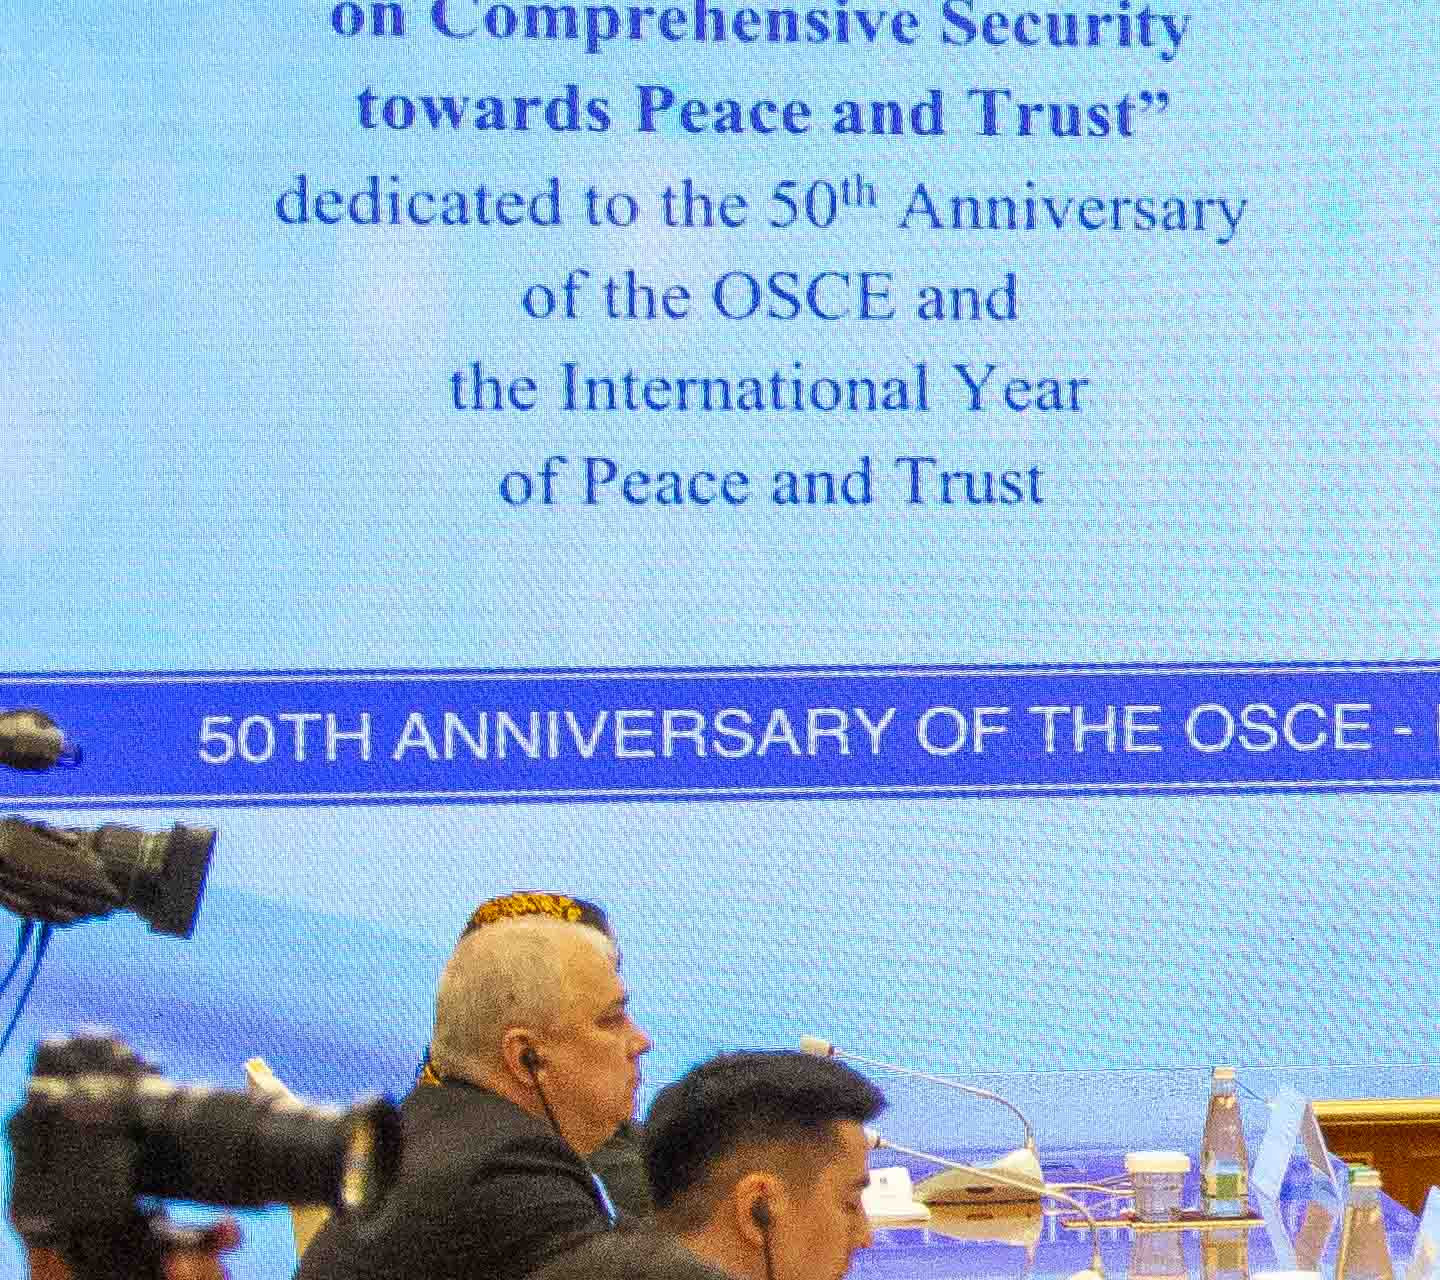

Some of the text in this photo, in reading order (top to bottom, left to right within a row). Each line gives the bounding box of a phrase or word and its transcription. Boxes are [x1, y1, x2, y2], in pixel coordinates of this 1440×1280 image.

[331, 1, 404, 36] on
[941, 0, 1192, 62] Security
[356, 83, 610, 132] towards
[637, 85, 811, 135] Peace
[832, 89, 944, 136] and
[274, 174, 561, 226] dedicated
[584, 187, 638, 227] to
[661, 178, 748, 229] the
[900, 180, 1247, 245] Anniversary
[521, 269, 1016, 321] of the OSCE and
[450, 361, 1089, 412] the International Year
[498, 455, 1042, 506] of Peace and Trust
[199, 712, 371, 764] 50TH
[393, 707, 896, 760] ANNIVERSARY
[917, 705, 1009, 756] OF
[1029, 704, 1162, 753] THE
[1184, 702, 1371, 753] OSCE
